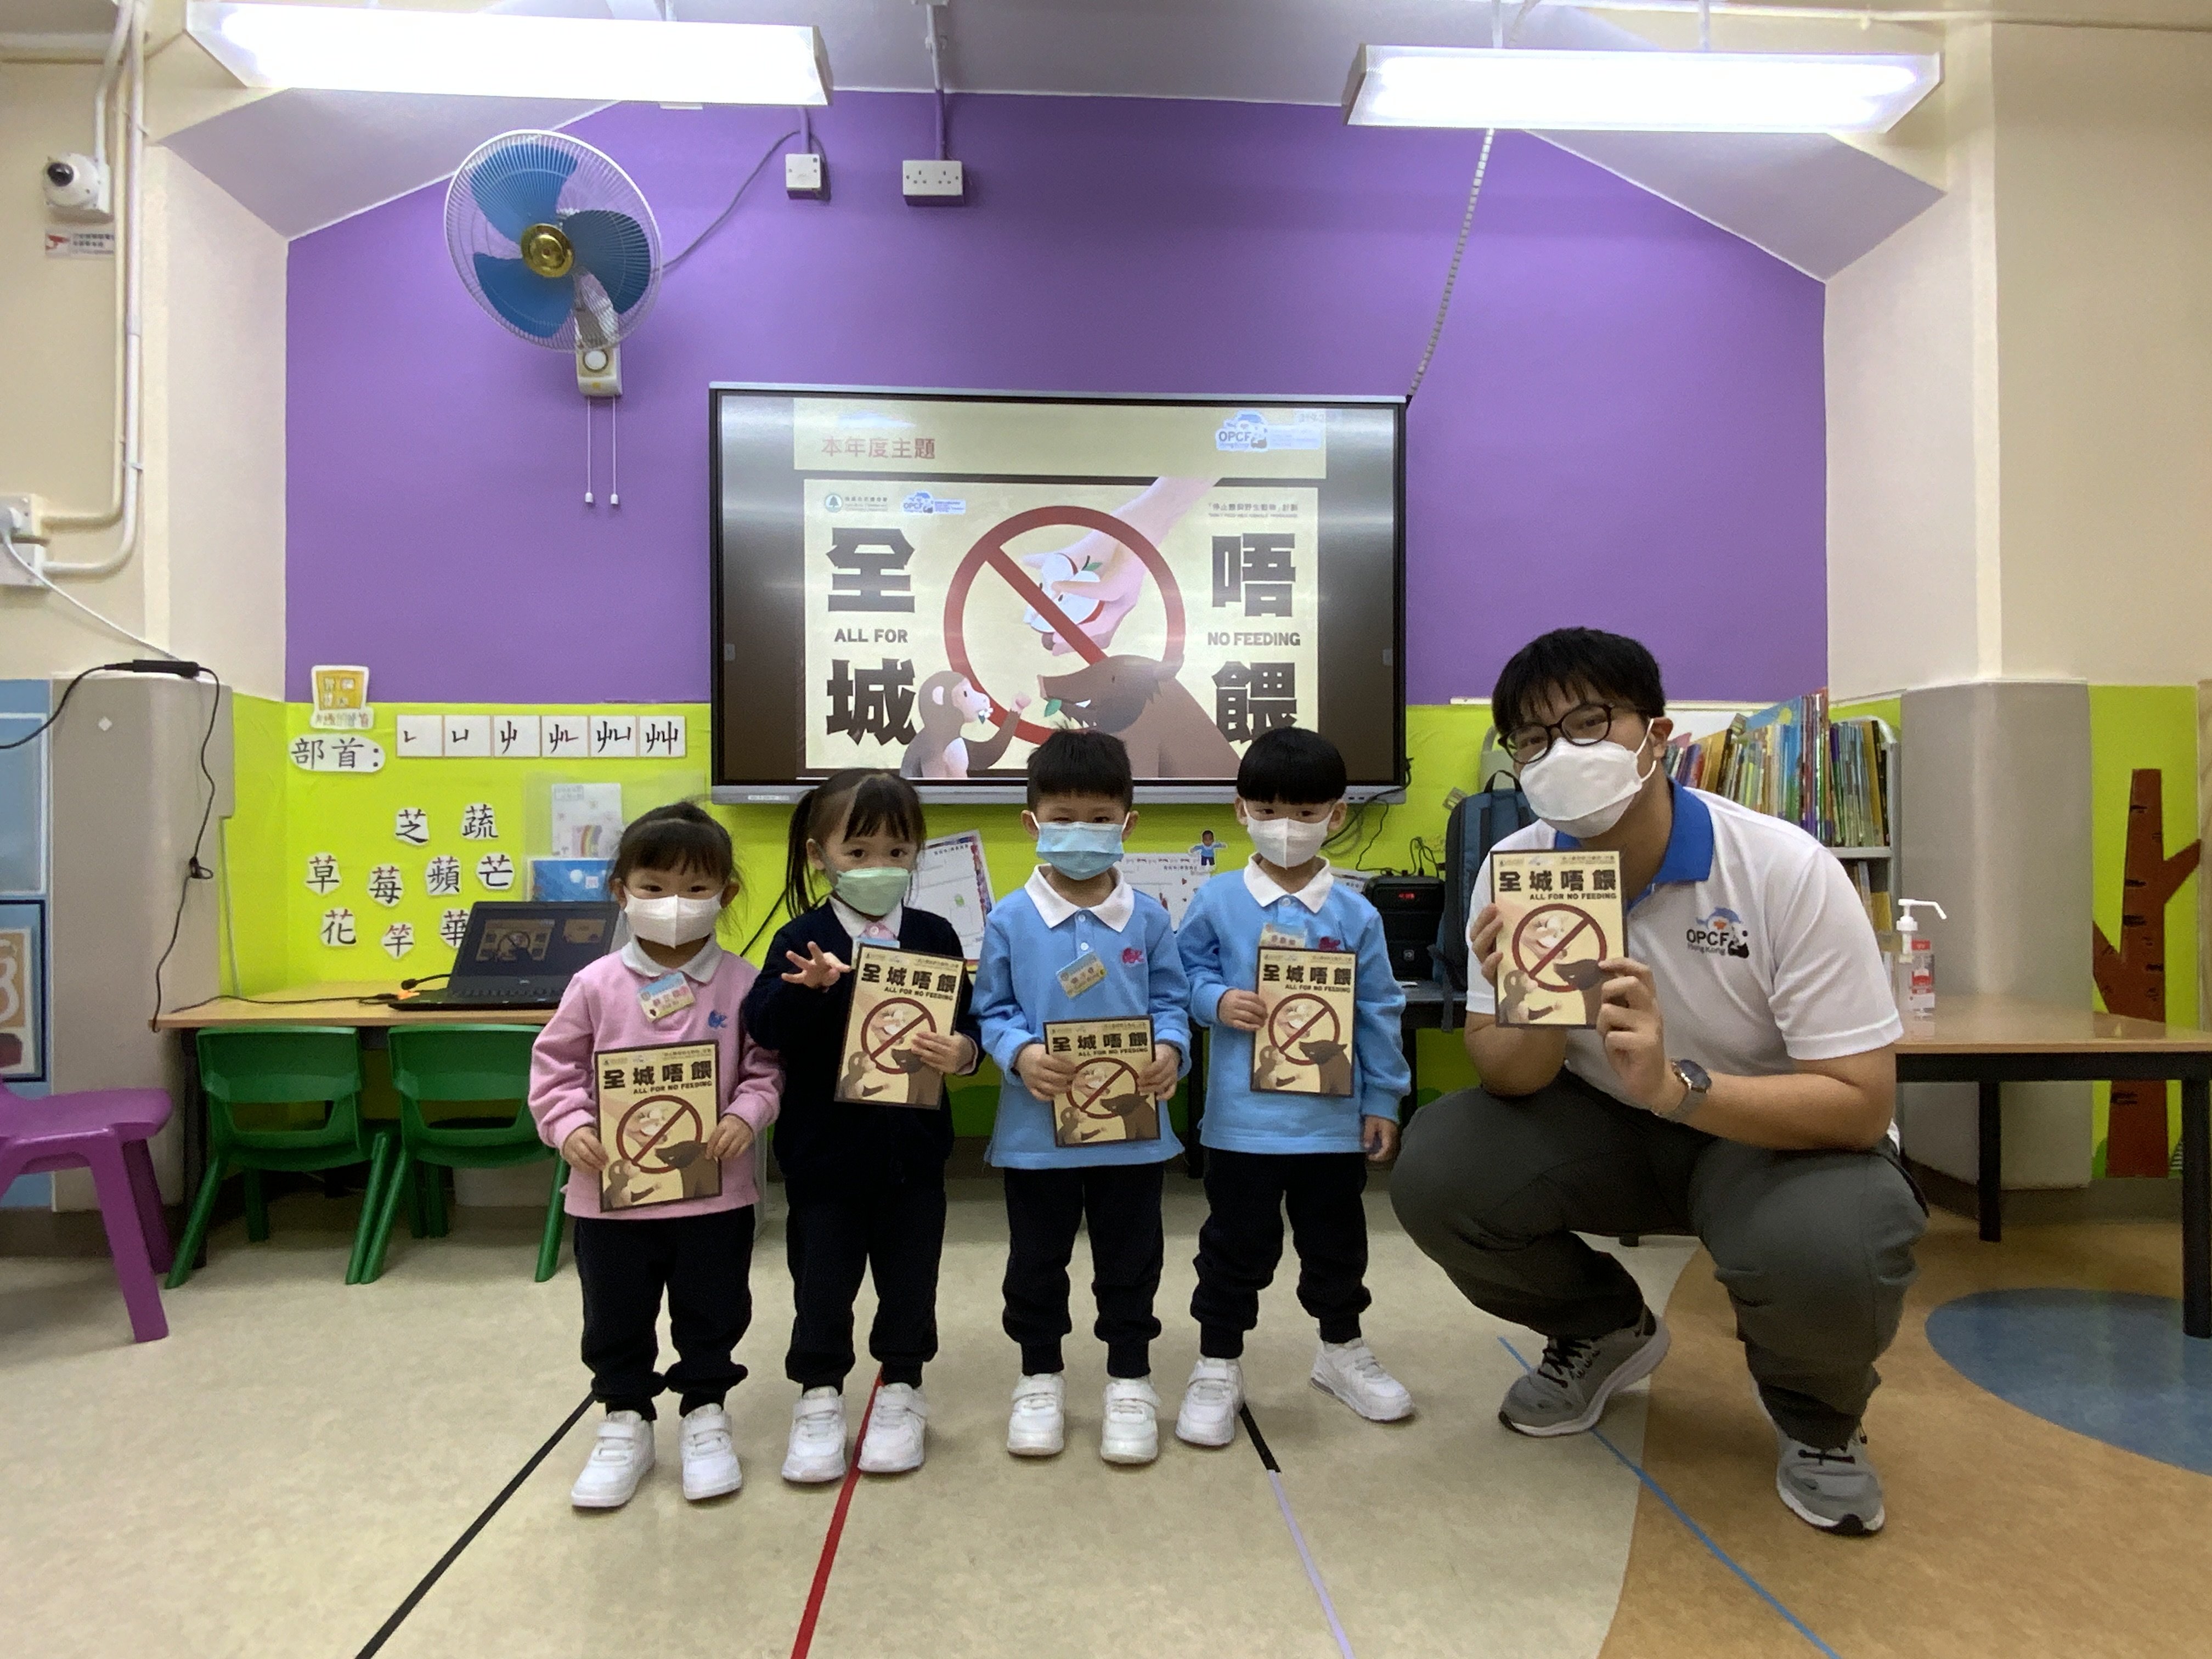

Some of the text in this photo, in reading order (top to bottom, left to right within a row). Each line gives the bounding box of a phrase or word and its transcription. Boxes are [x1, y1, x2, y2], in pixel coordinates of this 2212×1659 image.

[821, 436, 935, 460] 本年度主題
[1218, 431, 1251, 442] OPCF
[826, 527, 915, 613] 全
[1212, 533, 1296, 617] 唔
[834, 629, 909, 643] ALL FOR
[1208, 632, 1301, 646] NO FEEDING
[827, 658, 917, 745] 城
[1212, 661, 1297, 744] 餵
[396, 809, 428, 844] 芝
[462, 804, 499, 838] 蔬
[306, 855, 340, 893] 草
[369, 865, 402, 904] 莓
[427, 855, 460, 893] 蘋
[478, 854, 513, 887] 芒
[1499, 870, 1616, 891] 全城唔餵
[321, 909, 357, 945] 花
[1686, 929, 1729, 946] OPCF
[926, 992, 953, 1001] FEEDING
[681, 1081, 712, 1090] FEEDING
